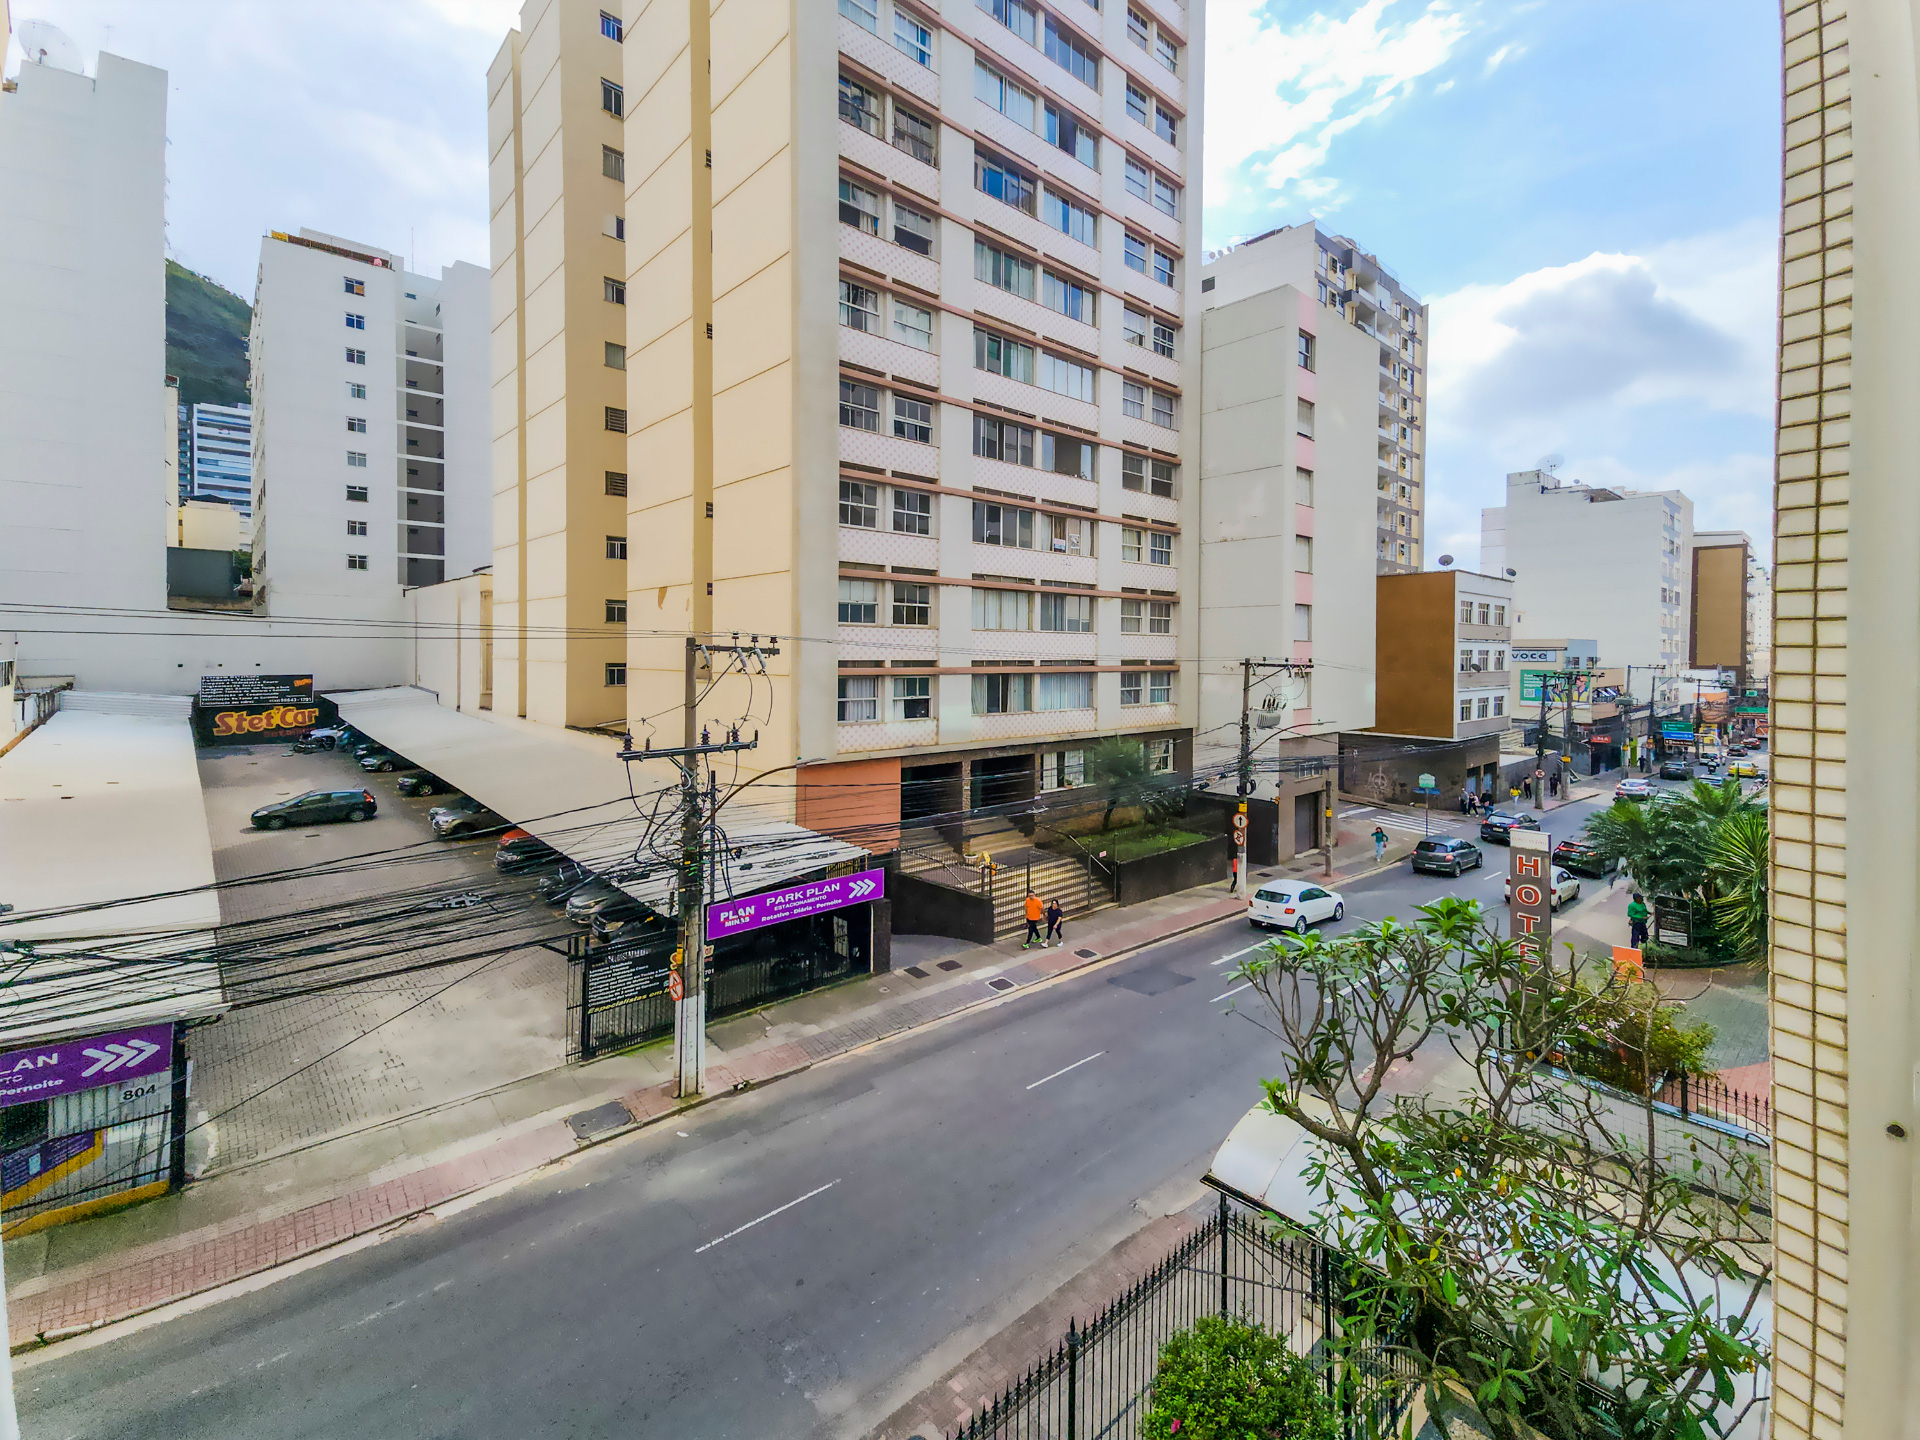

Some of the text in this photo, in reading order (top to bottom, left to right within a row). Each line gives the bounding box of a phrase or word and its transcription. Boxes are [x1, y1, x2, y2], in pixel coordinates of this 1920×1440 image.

[766, 883, 841, 907] PARK PLAN
[774, 894, 827, 911] ESTACIONAMENTO
[720, 905, 755, 922] PLAN
[761, 911, 790, 922] Rotativo
[816, 898, 843, 909] Pernoite
[725, 916, 750, 927] MINAS
[123, 1084, 157, 1101] 804
